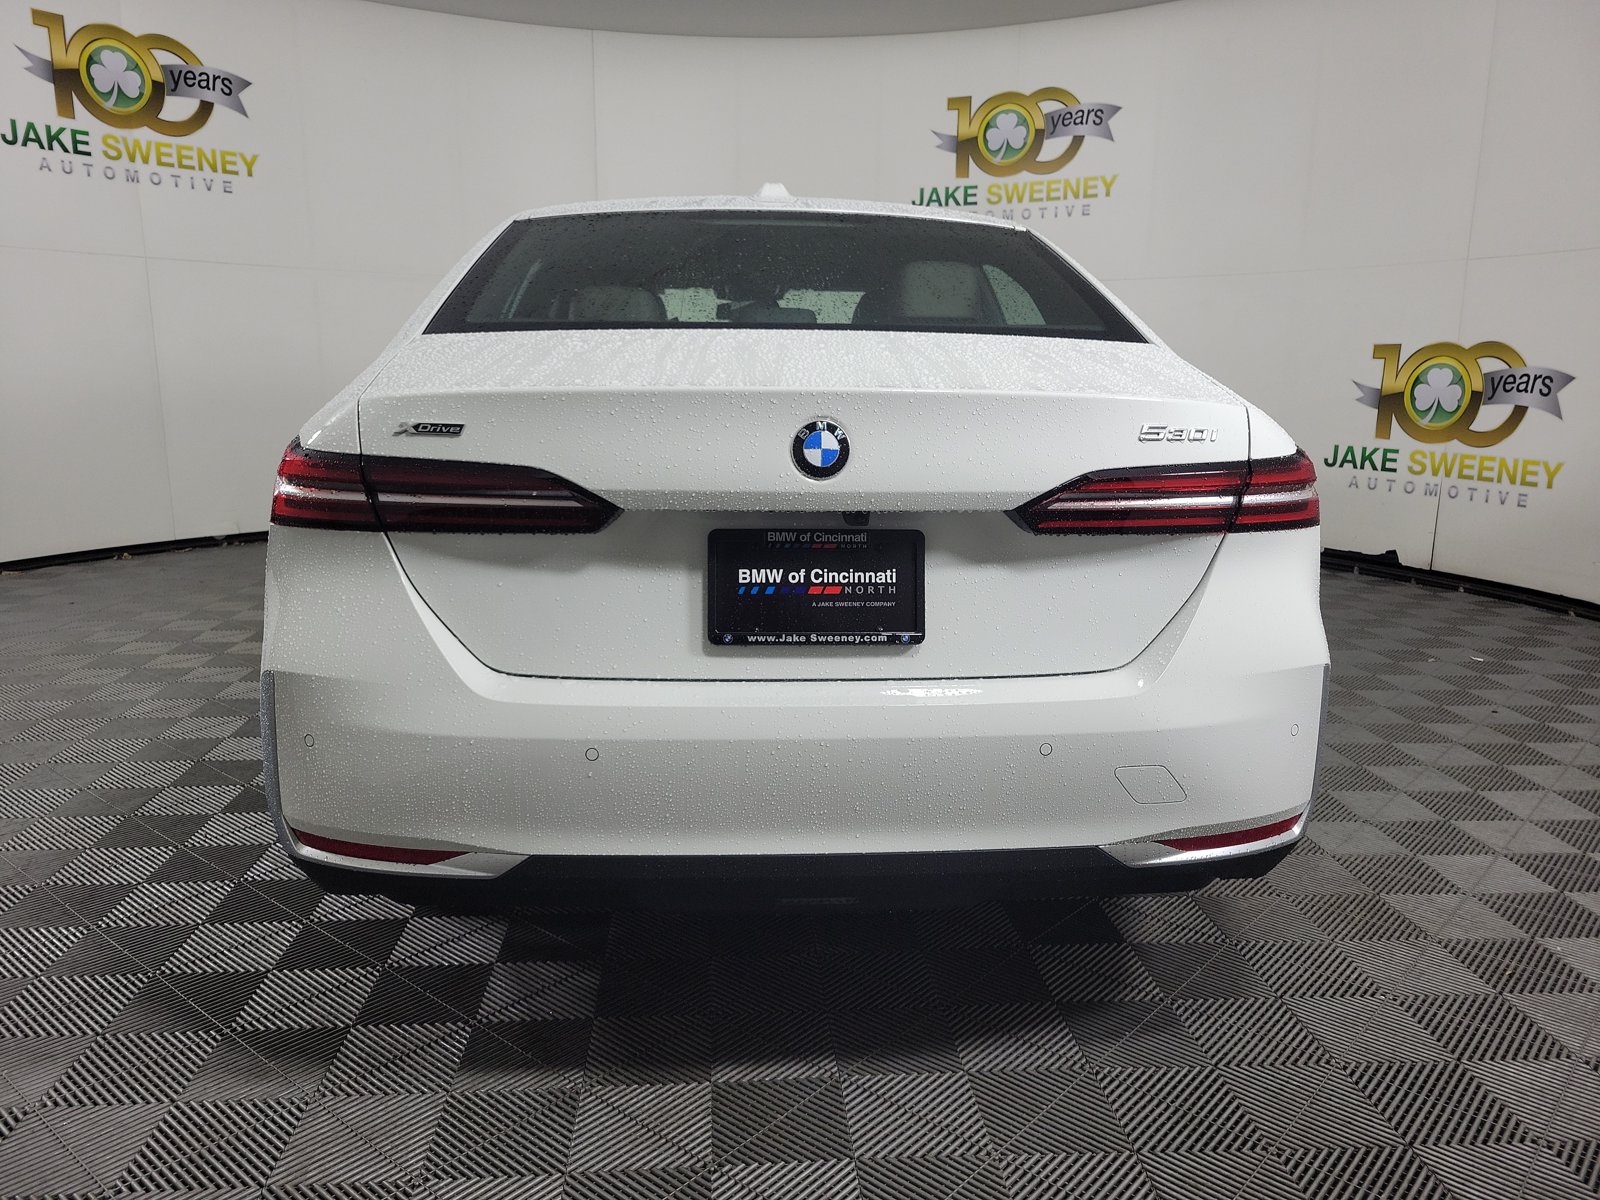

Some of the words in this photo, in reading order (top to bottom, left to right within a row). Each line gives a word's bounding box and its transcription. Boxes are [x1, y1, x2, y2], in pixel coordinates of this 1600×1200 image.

[169, 69, 233, 96] years
[1050, 107, 1104, 134] years
[1, 119, 92, 156] JAKE
[101, 134, 259, 177] SWEENEY
[39, 157, 233, 193] AUTOMOTIVE
[911, 185, 978, 207] JAKE
[986, 174, 1119, 205] SWEENEY
[1487, 373, 1554, 400] years
[798, 421, 846, 440] BMW
[1323, 445, 1400, 472] JAKE
[1407, 450, 1564, 489] SWEENEY
[1348, 475, 1529, 508] AUTOMOTIVE
[767, 532, 797, 542] BMW
[800, 532, 811, 542] of
[813, 532, 867, 542] Cincinnati
[738, 569, 783, 583] BMW
[788, 569, 806, 583] of
[810, 569, 897, 583] Cincinnati
[844, 586, 896, 594] NORTH
[747, 634, 806, 642] www.Jake
[810, 634, 888, 644] Sweeney.com
